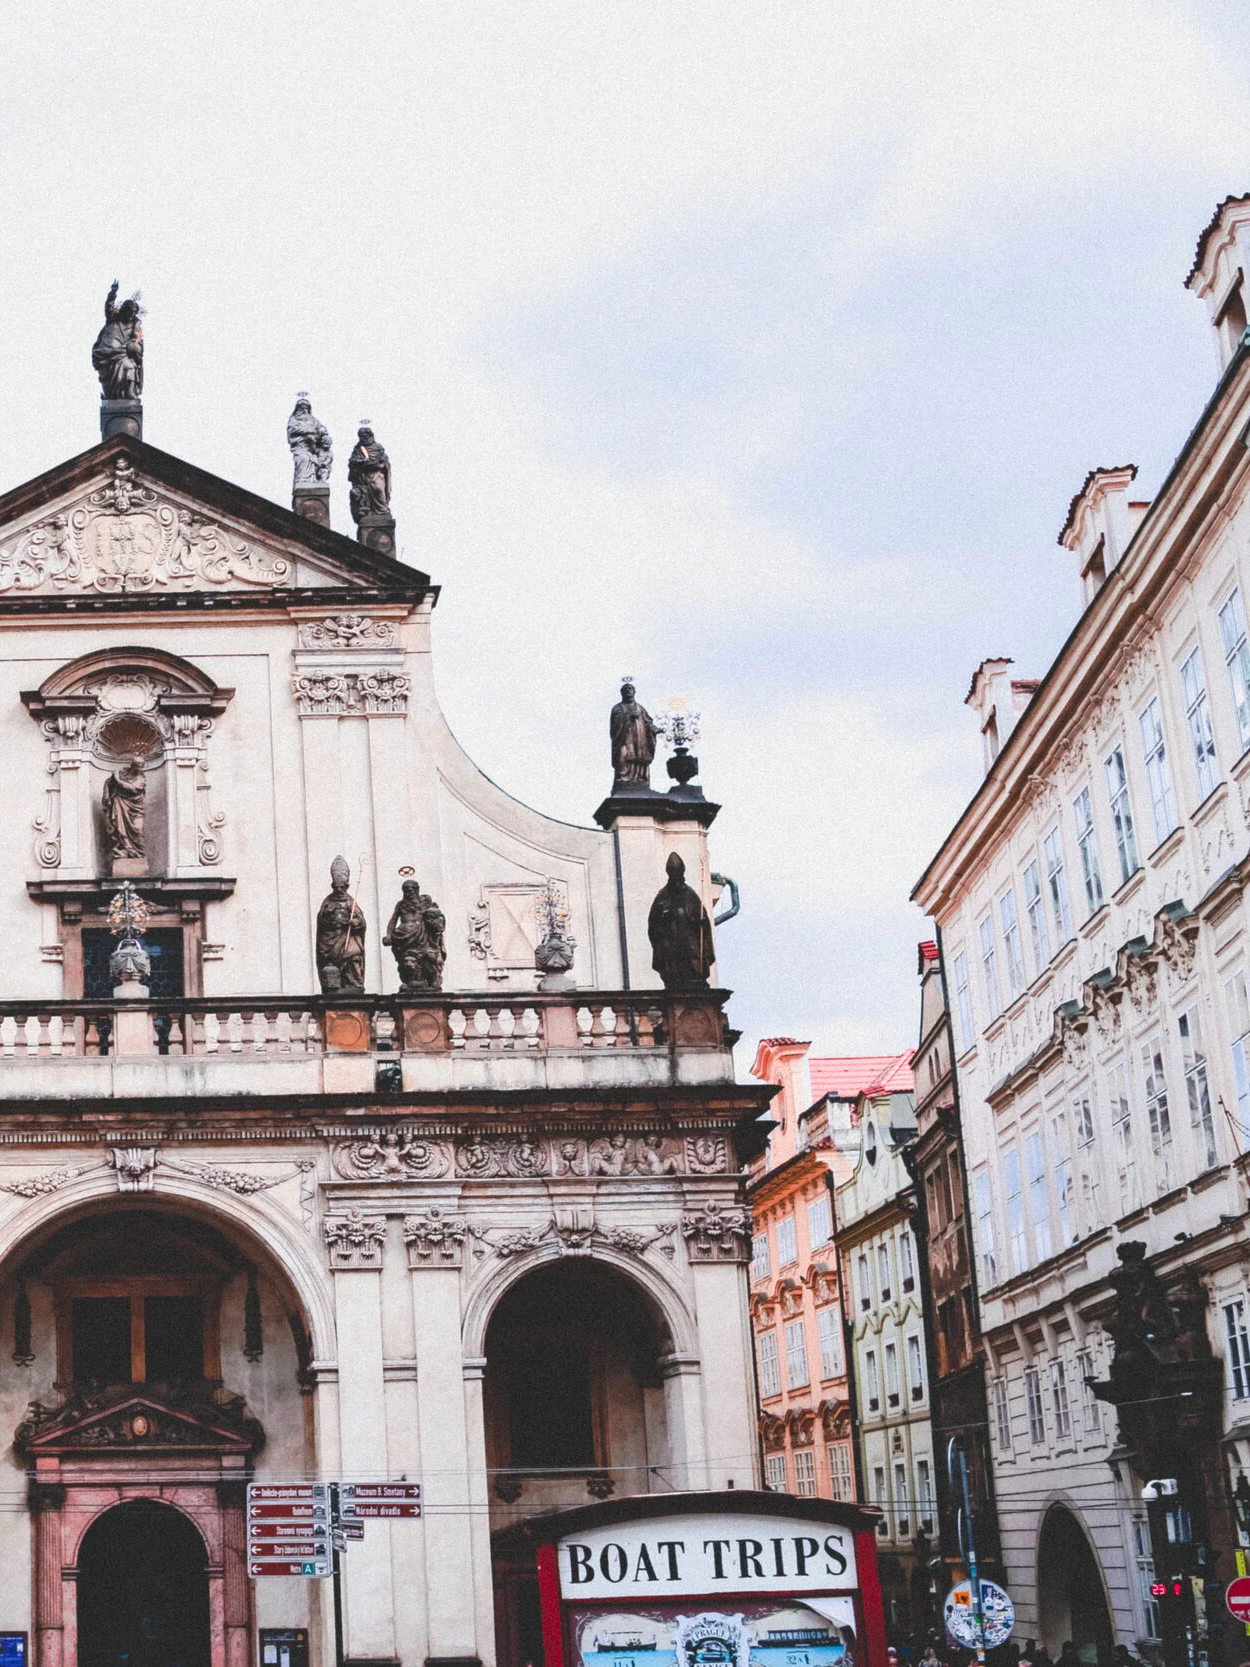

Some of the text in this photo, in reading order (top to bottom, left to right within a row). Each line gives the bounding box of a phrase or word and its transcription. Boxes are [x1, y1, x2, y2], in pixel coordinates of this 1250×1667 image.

[355, 1487, 377, 1496] Muzeum
[383, 1487, 406, 1498] Smetany
[356, 1506, 401, 1516] Národní divadlo
[565, 1535, 849, 1584] BOAT TRIPS
[304, 1564, 312, 1573] A
[1152, 1583, 1165, 1595] 23
[695, 1629, 726, 1639] PRAGUE
